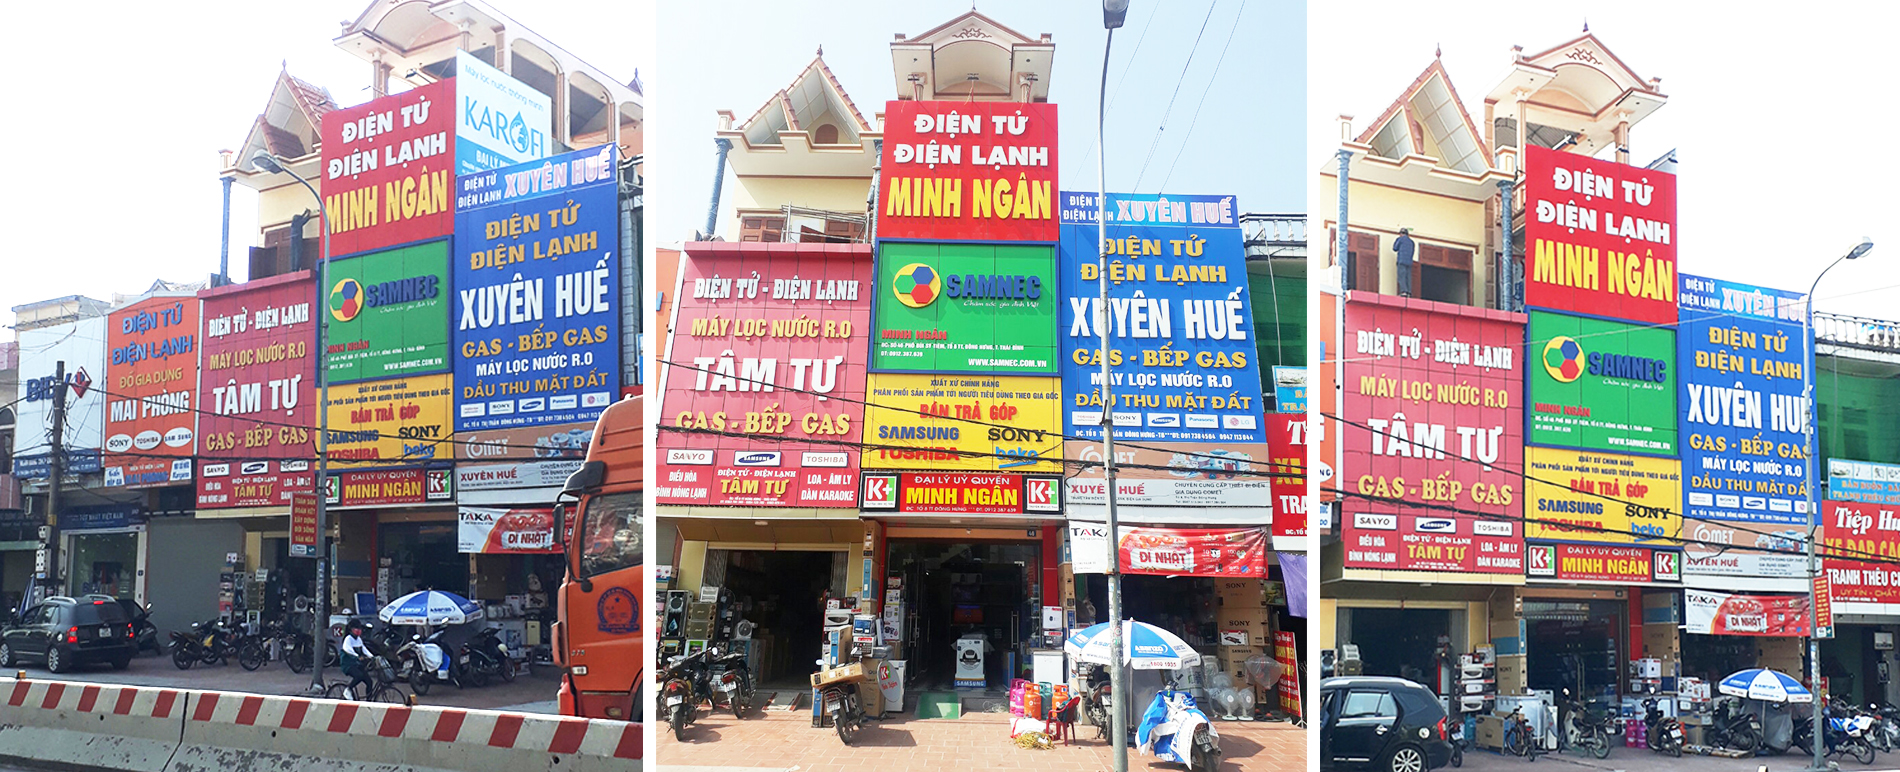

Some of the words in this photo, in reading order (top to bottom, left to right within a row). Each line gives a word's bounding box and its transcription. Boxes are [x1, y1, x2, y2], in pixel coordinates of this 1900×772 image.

[342, 111, 393, 144] ĐIỆN
[401, 95, 431, 128] TỬ
[914, 110, 981, 138] ĐIỆN
[992, 110, 1029, 135] TỬ
[328, 148, 378, 180] ĐIỆN
[385, 132, 446, 168] LẠNH
[894, 139, 961, 169] ĐIỆN
[972, 146, 1048, 170] LẠNH
[504, 161, 567, 198] XUYÊN
[572, 144, 614, 185] HUẾ
[326, 185, 378, 234] MINH
[386, 165, 447, 223] NGÂN
[887, 177, 961, 217] MINH
[972, 172, 1051, 219] NGÂN
[1553, 167, 1613, 201] ĐIỆN
[1622, 178, 1654, 206] TỬ
[485, 213, 540, 240] ĐIỆN
[548, 200, 581, 229] TỬ
[1116, 198, 1186, 223] XUYÊN
[1191, 197, 1233, 224] HUẾ
[1536, 200, 1597, 234] ĐIỆN
[1605, 213, 1670, 245] LẠNH
[470, 243, 525, 270] ĐIỆN
[533, 231, 597, 261] LẠNH
[1533, 238, 1599, 290] MINH
[1608, 249, 1673, 302] NGÂN
[366, 274, 439, 308] SAMNEC
[460, 273, 543, 331] XUYÊN
[556, 252, 611, 318] HUẾ
[693, 274, 732, 303] ĐIỆN
[737, 271, 761, 299] TỬ
[773, 275, 811, 304] ĐIỆN
[815, 279, 858, 304] LẠNH
[946, 274, 1040, 299] SAMNEC
[123, 310, 157, 335] ĐIỆN
[209, 314, 230, 340] ĐIỆN
[233, 307, 247, 333] TỬ
[255, 306, 279, 332] ĐIỆN
[281, 303, 309, 328] LẠNH
[691, 314, 730, 336] MÁY
[734, 318, 767, 341] LỌC
[771, 314, 819, 337] NƯỚC
[824, 319, 852, 338] R.O
[112, 341, 146, 366] ĐIỆN
[150, 335, 192, 360] LẠNH
[462, 339, 502, 359] GAS
[518, 323, 558, 352] BẾP
[563, 325, 608, 346] GAS
[1357, 328, 1394, 360] ĐIỆN
[1399, 328, 1422, 359] TỬ
[1435, 337, 1469, 369] ĐIỆN
[1473, 345, 1512, 372] LẠNH
[1709, 326, 1756, 350] ĐIỆN
[1762, 329, 1789, 352] TỬ
[210, 350, 231, 370] MÁY
[235, 349, 254, 369] LỌC
[256, 341, 285, 364] NƯỚC
[288, 341, 305, 358] R.O
[476, 359, 502, 377] MÁY
[506, 359, 529, 375] LỌC
[533, 351, 567, 370] NƯỚC
[572, 352, 593, 367] R.O
[968, 359, 1047, 367] WWW.SAMNEC.COM.VN
[1588, 351, 1667, 383] SAMNEC
[1695, 350, 1744, 374] ĐIỆN
[1751, 358, 1802, 379] LẠNH
[694, 349, 777, 392] TÂM
[790, 356, 844, 401] TỰ
[213, 378, 261, 415] TÂM
[269, 374, 301, 416] TỰ
[1360, 373, 1397, 398] MÁY
[1403, 380, 1432, 404] LỌC
[1437, 381, 1480, 405] NƯỚC
[1484, 389, 1508, 409] R.O
[111, 399, 136, 422] MAI
[142, 390, 189, 418] PHÒNG
[675, 411, 727, 431] GAS
[744, 402, 792, 433] BẾP
[801, 413, 851, 435] GAS
[920, 401, 949, 418] BÁN
[955, 401, 981, 420] TRẢ
[990, 402, 1017, 420] GÓP
[109, 438, 129, 447] SONY
[206, 431, 235, 451] GAS
[245, 422, 272, 448] BẾP
[279, 426, 308, 445] GAS
[879, 426, 959, 440] SAMSUNG
[988, 428, 1046, 442] SONY
[1368, 412, 1445, 460] TÂM
[1457, 426, 1503, 471] TỰ
[807, 474, 822, 484] LOA
[829, 473, 842, 484] ÂM
[843, 475, 851, 484] LY
[915, 476, 935, 484] ĐẠI
[938, 476, 951, 484] LÝ
[971, 475, 1010, 485] QUYỀN
[1703, 455, 1727, 470] MÁY
[1730, 459, 1750, 476] LỌC
[1753, 459, 1781, 475] NƯỚC
[1785, 464, 1802, 477] R.O
[346, 484, 379, 499] MINH
[384, 479, 421, 498] NGÂN
[721, 477, 759, 494] TÂM
[765, 479, 789, 496] TỰ
[801, 489, 818, 501] DÀN
[819, 490, 854, 501] KARAOKE
[906, 487, 958, 505] MINH
[964, 486, 1017, 506] NGÂN
[1358, 475, 1405, 498] GAS
[1421, 471, 1462, 501] BẾP
[1471, 482, 1513, 506] GAS
[1571, 477, 1594, 493] BÁN
[1598, 479, 1620, 496] TRẢ
[1626, 481, 1648, 498] GÓP
[1538, 498, 1603, 515] SAMSUNG
[1625, 504, 1670, 519] SONY
[1835, 506, 1872, 535] Tiệp
[1631, 522, 1664, 536] beko
[1139, 552, 1151, 562] ĐI
[1156, 550, 1185, 567] NHẬT
[1562, 557, 1603, 573] MINH
[1607, 557, 1648, 575] NGÂN
[1826, 569, 1860, 585] TRANH
[1863, 568, 1888, 586] THÊU
[1687, 595, 1718, 604] TAKA
